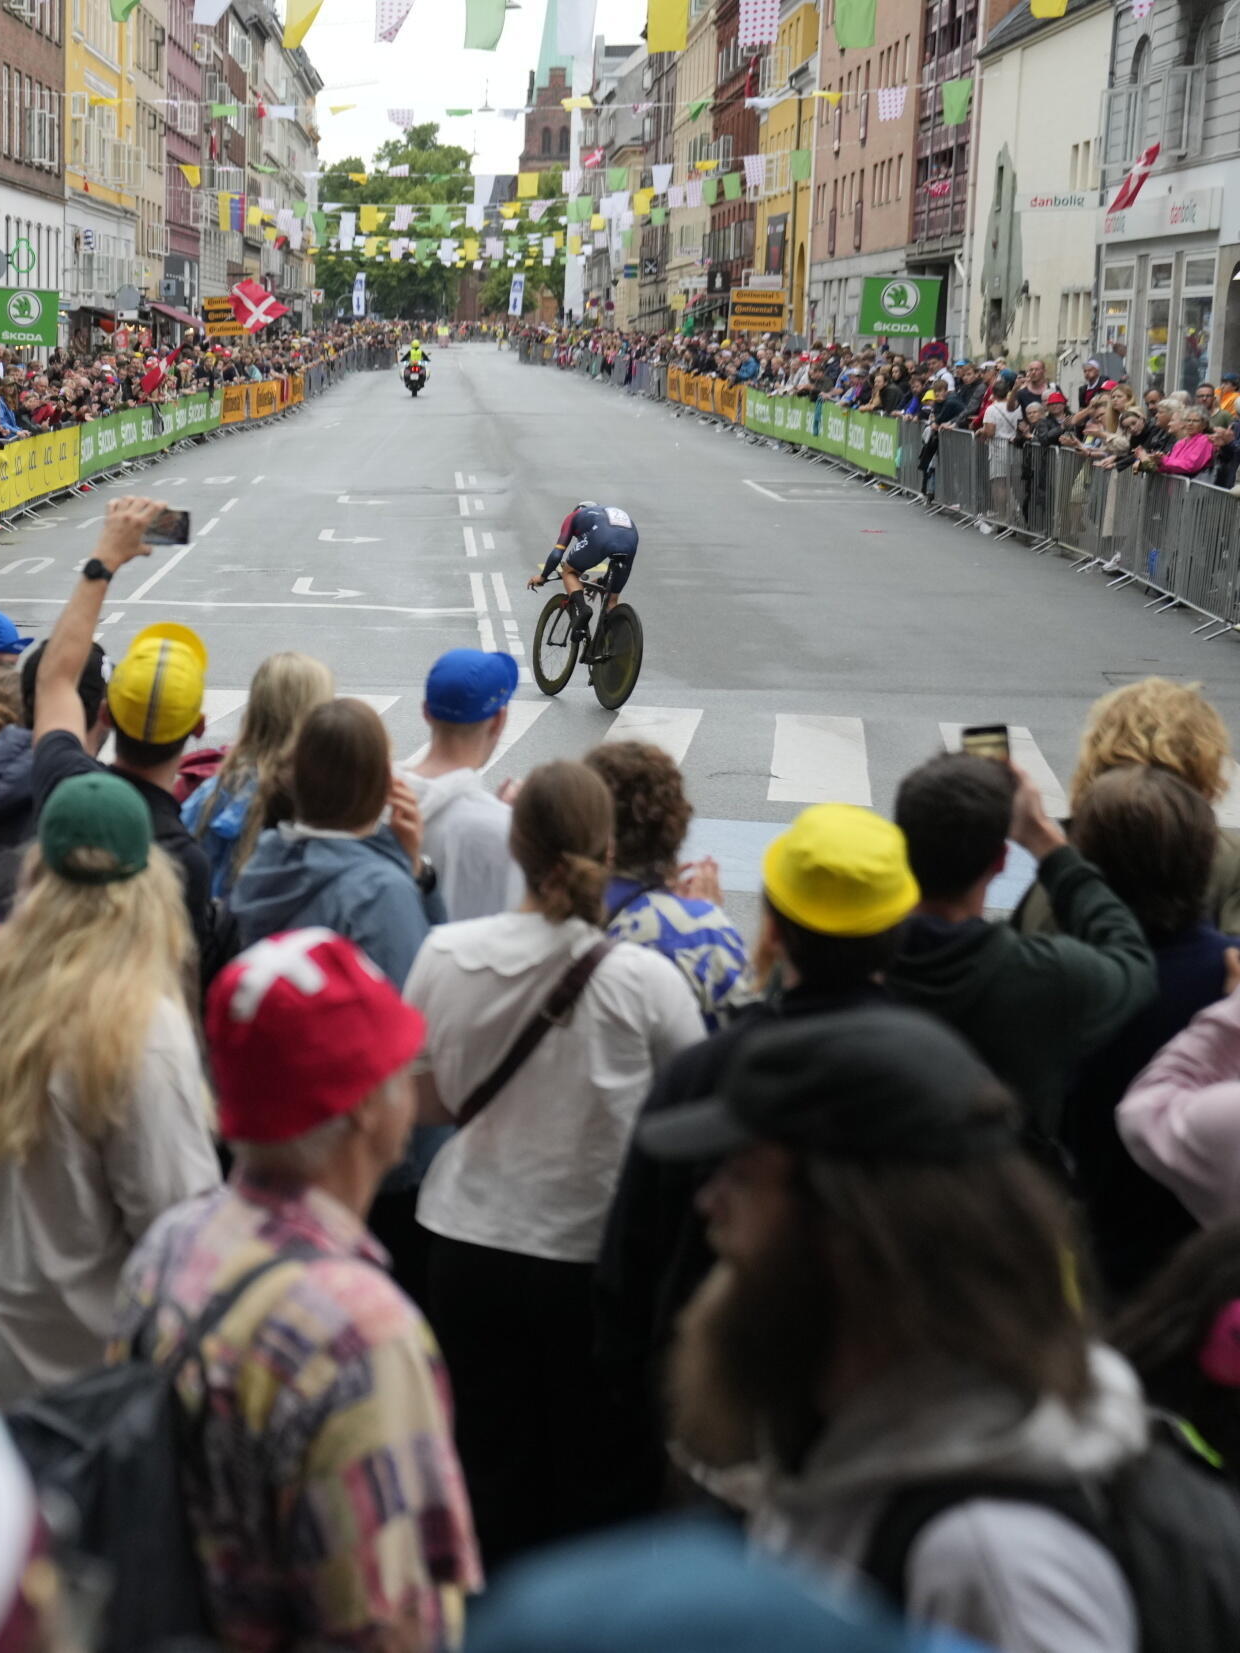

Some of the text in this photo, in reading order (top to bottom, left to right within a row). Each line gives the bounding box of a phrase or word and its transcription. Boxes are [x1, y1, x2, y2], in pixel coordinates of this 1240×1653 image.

[1030, 196, 1084, 208] danbolig
[734, 304, 772, 314] Continental
[873, 321, 920, 333] ŠKODA
[2, 331, 43, 342] ŠKODA
